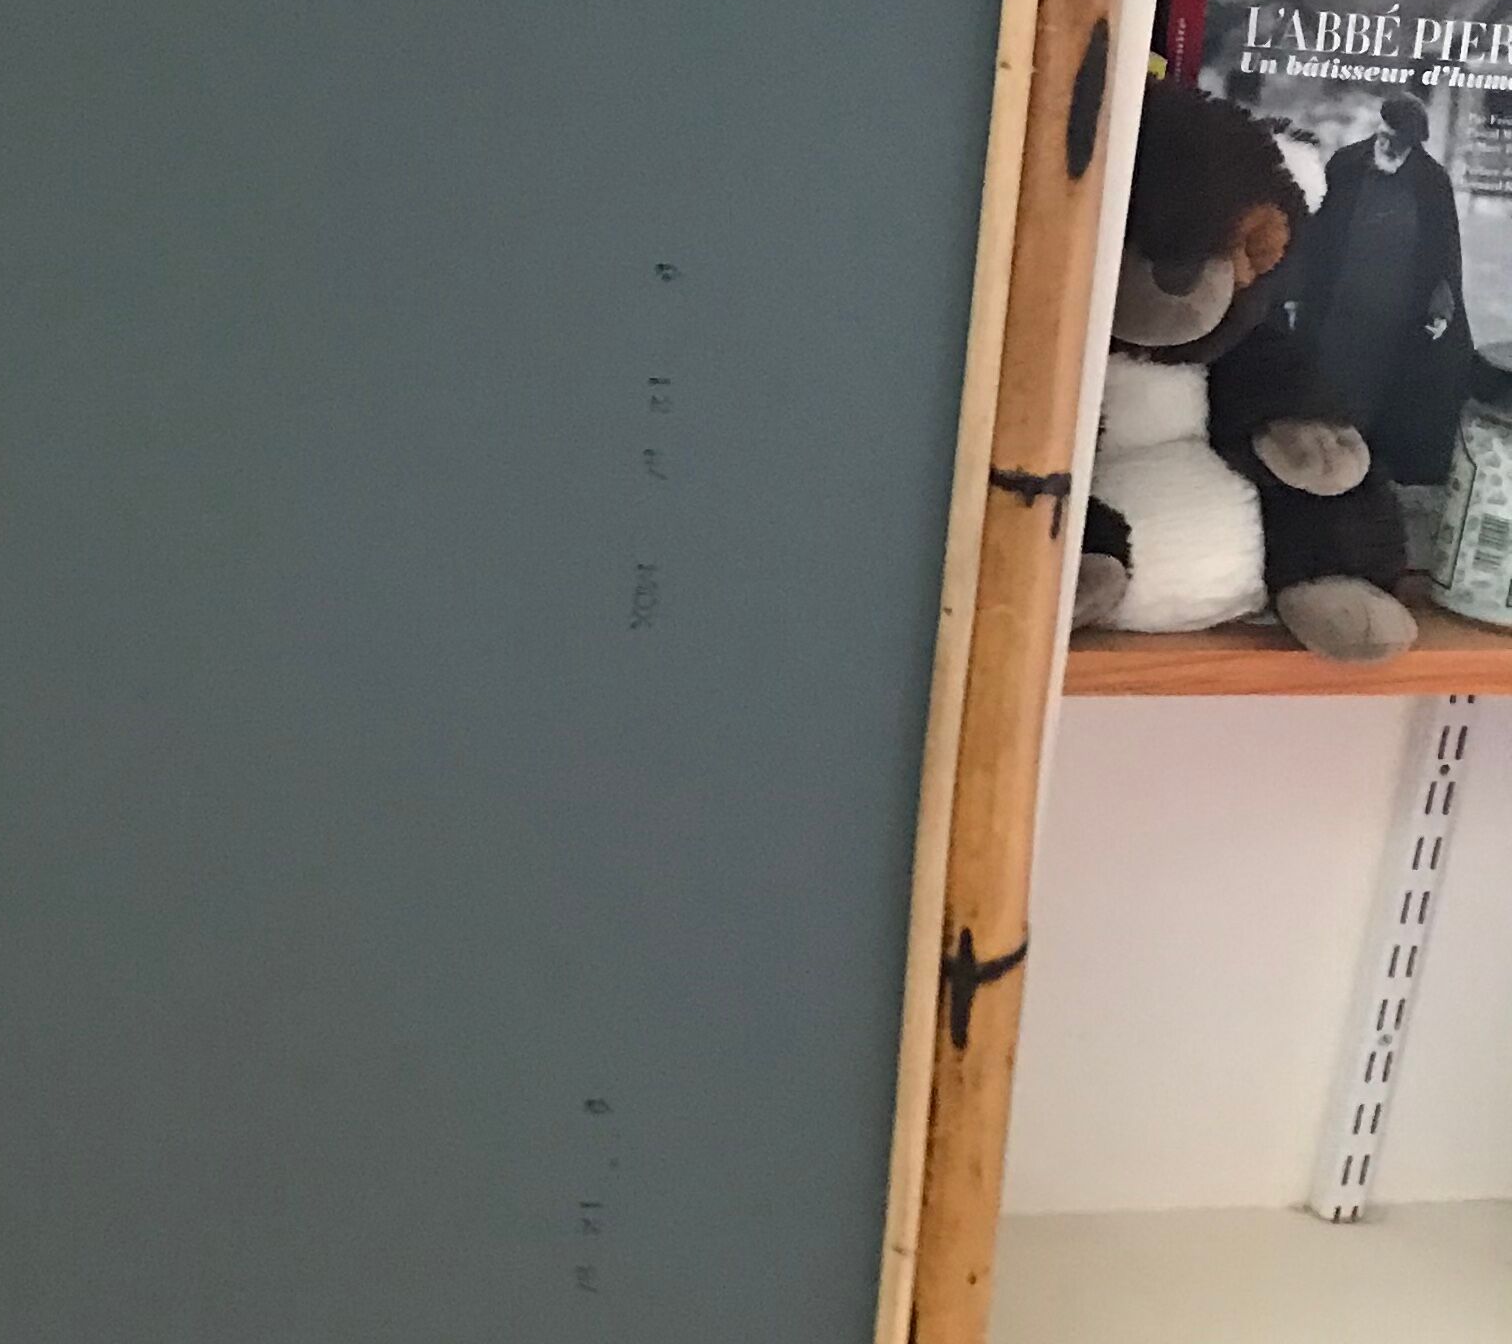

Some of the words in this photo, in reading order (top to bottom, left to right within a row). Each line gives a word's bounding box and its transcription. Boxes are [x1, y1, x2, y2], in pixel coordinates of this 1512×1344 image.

[1242, 3, 1402, 57] L'ABBÉ
[1241, 51, 1278, 74] Un
[1286, 55, 1415, 84] bâtisseur
